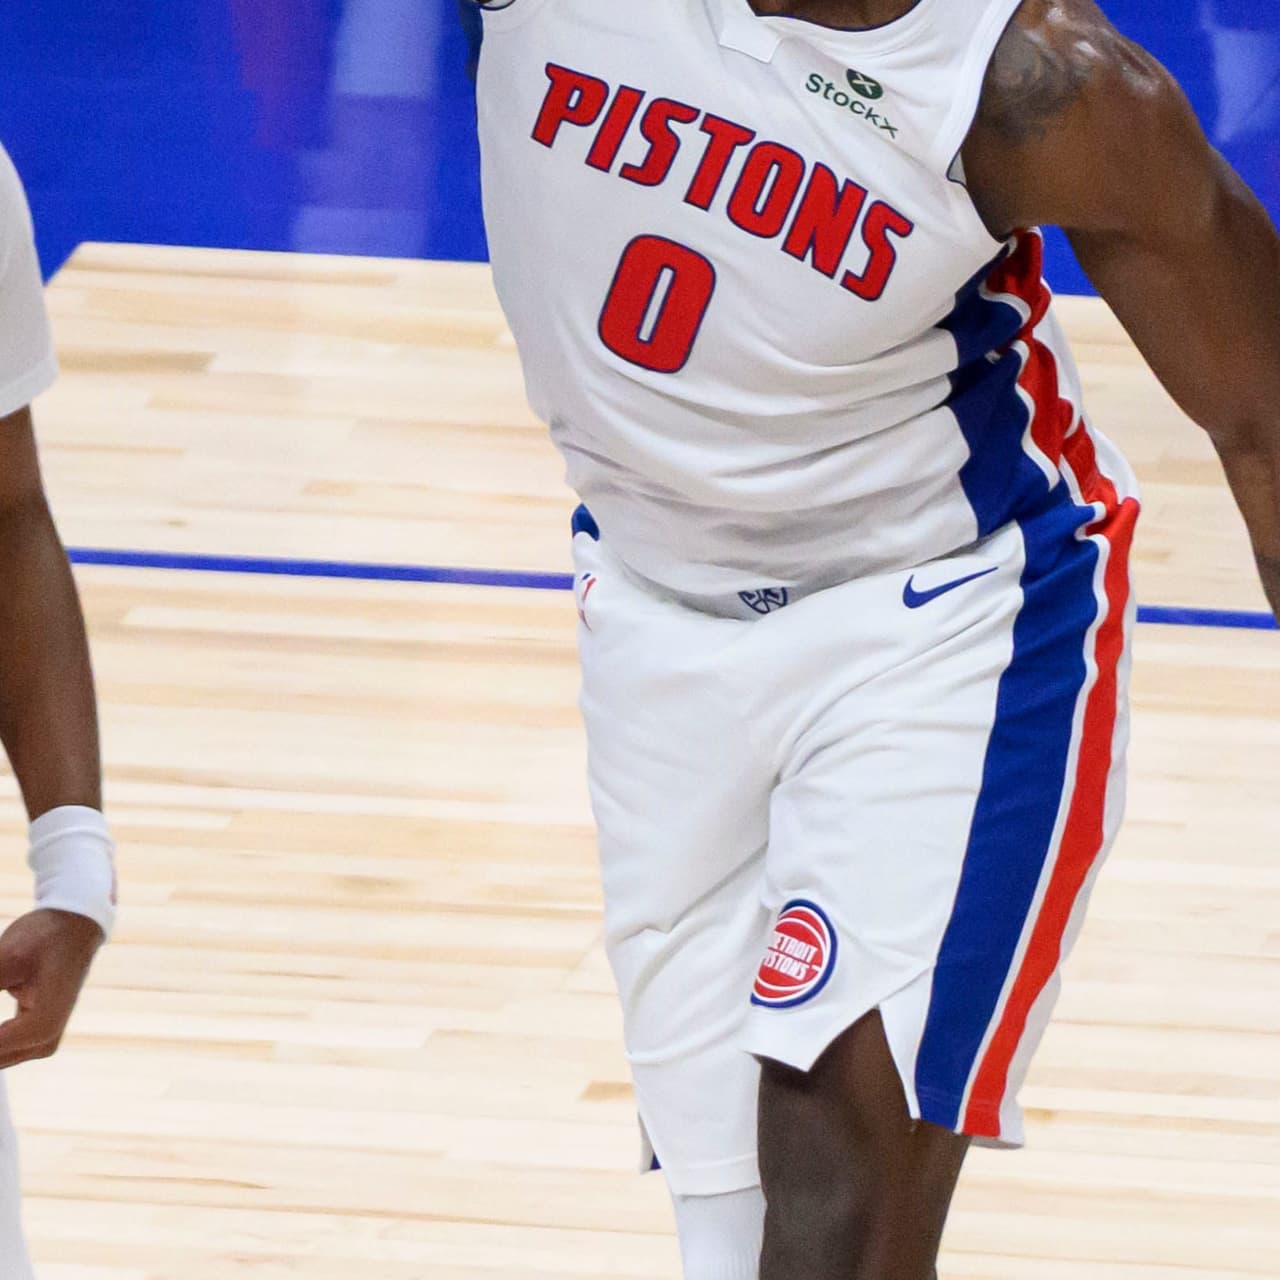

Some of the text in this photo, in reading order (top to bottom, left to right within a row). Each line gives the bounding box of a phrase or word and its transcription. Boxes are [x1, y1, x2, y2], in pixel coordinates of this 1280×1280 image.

[805, 72, 899, 140] StockX
[530, 61, 915, 302] PISTONS
[597, 233, 717, 375] 0
